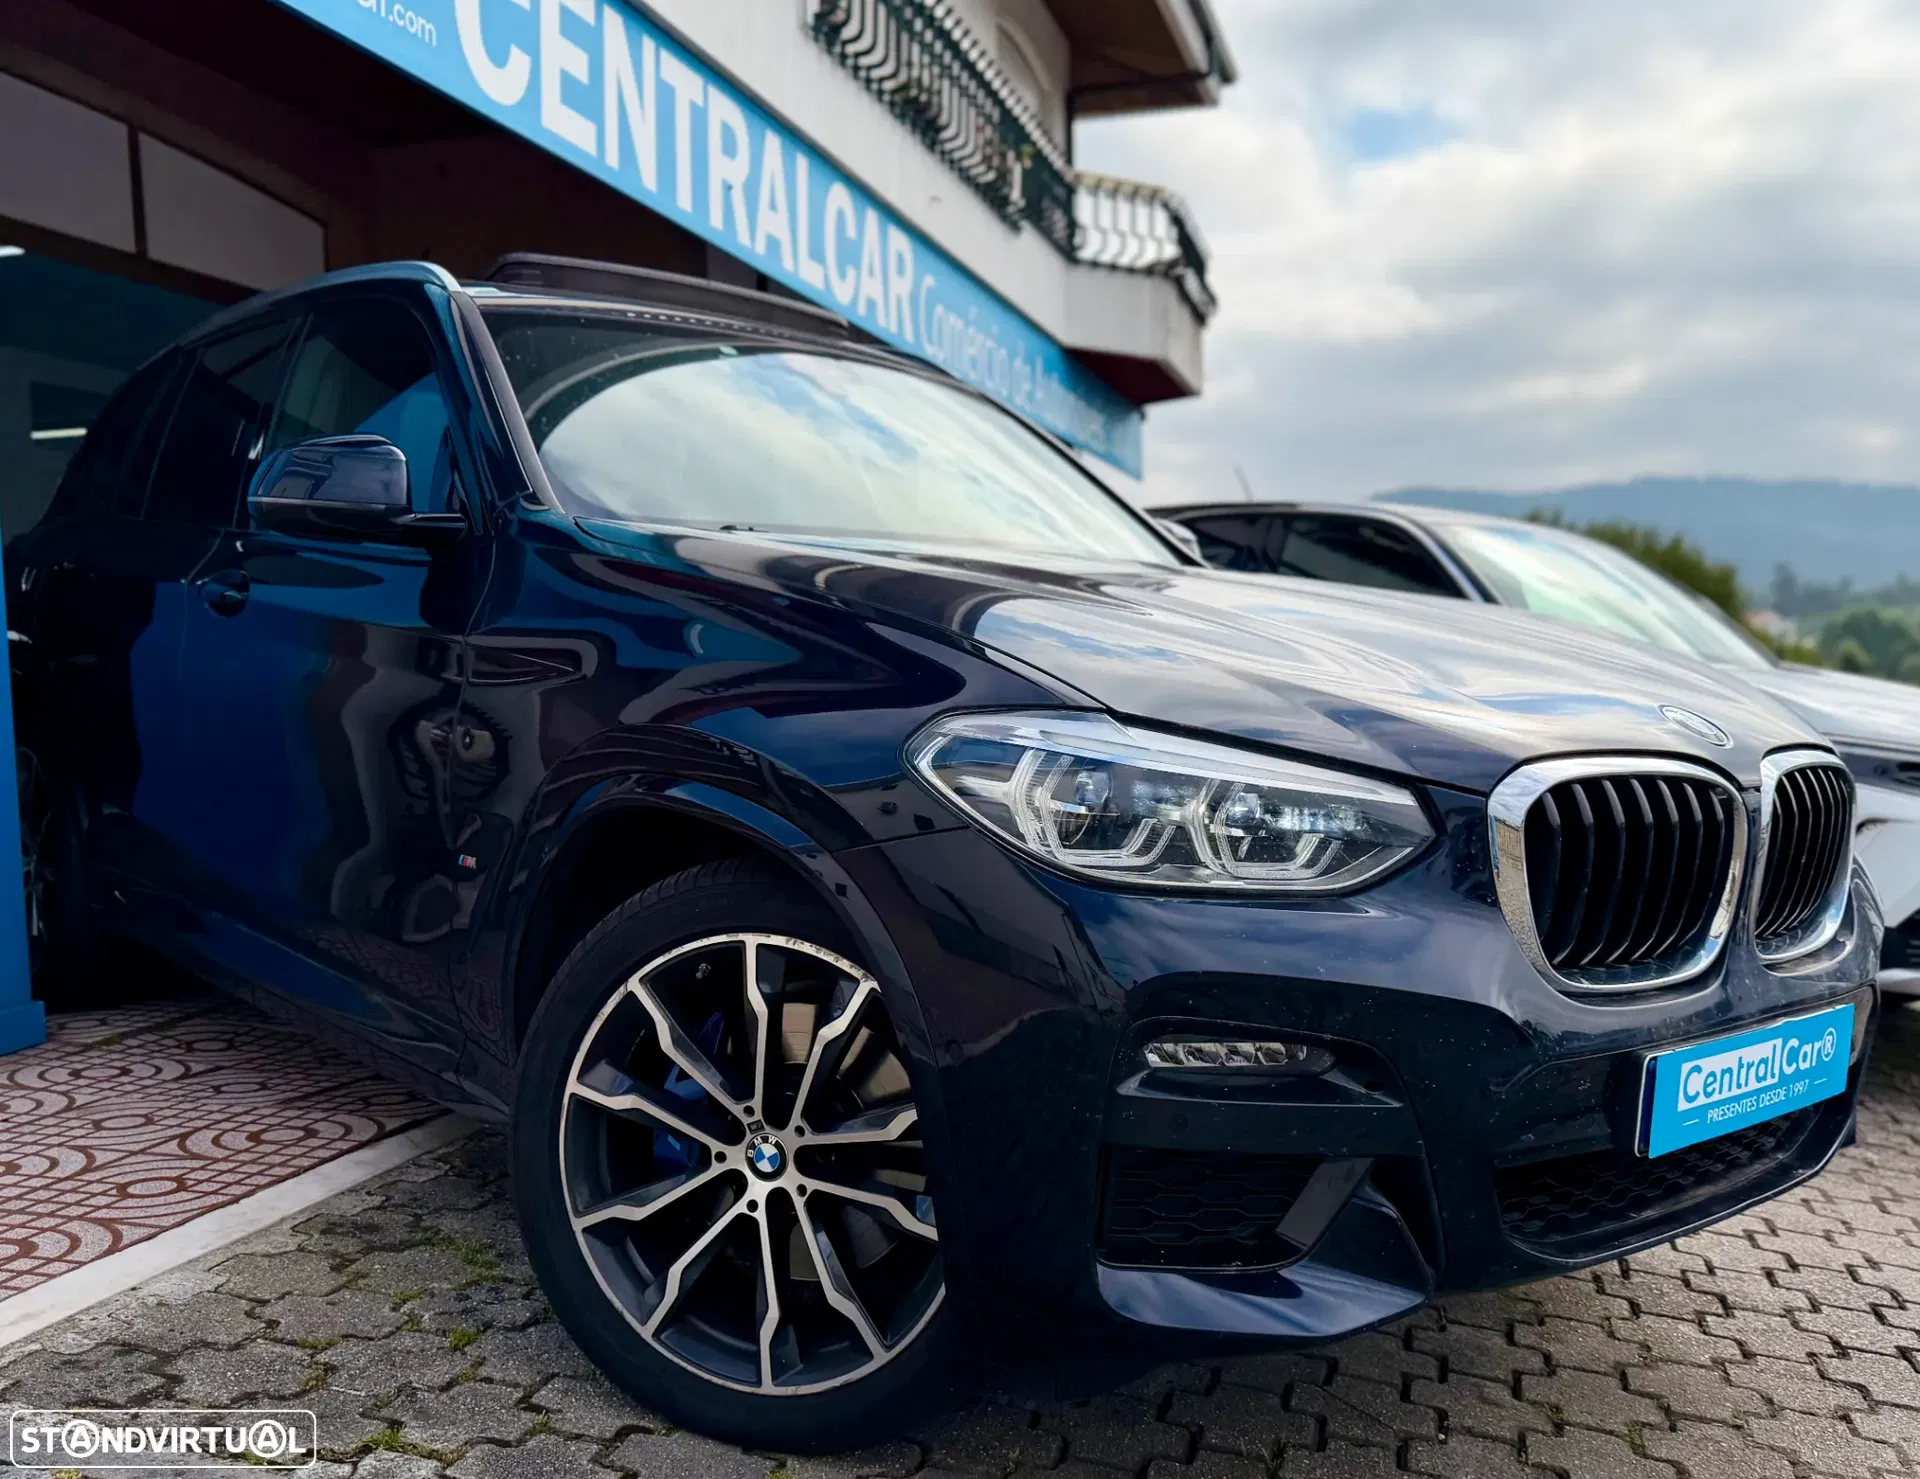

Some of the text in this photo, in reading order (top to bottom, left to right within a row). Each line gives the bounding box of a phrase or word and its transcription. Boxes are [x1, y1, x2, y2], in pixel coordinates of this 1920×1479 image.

[453, 0, 914, 344] CENTRALCAR
[1707, 1080, 1809, 1124] PRESENTES DESDE 1997
[746, 1134, 778, 1158] BMW
